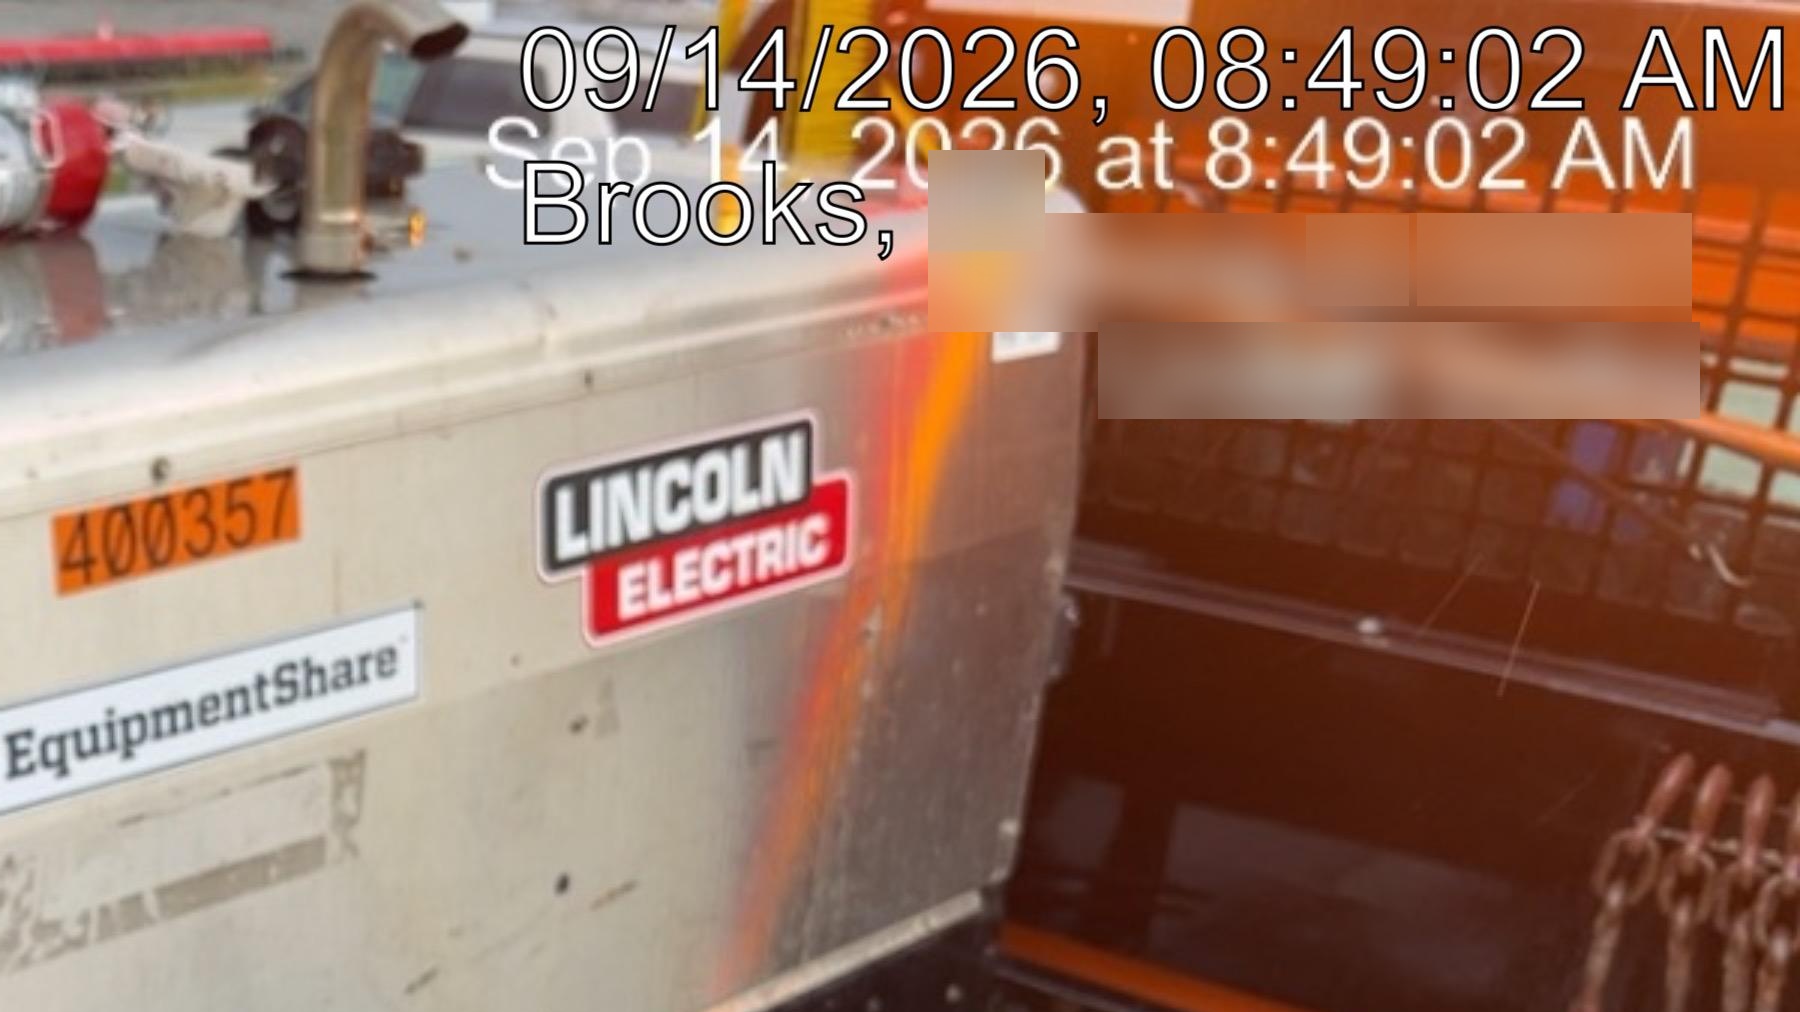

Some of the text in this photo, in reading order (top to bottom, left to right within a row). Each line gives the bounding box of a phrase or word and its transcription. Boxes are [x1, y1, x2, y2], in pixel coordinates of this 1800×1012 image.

[58, 465, 297, 586] 400357
[555, 429, 806, 563] LINCOLN
[616, 512, 831, 621] ELECTRIC
[3, 643, 400, 778] EquipmentShare
